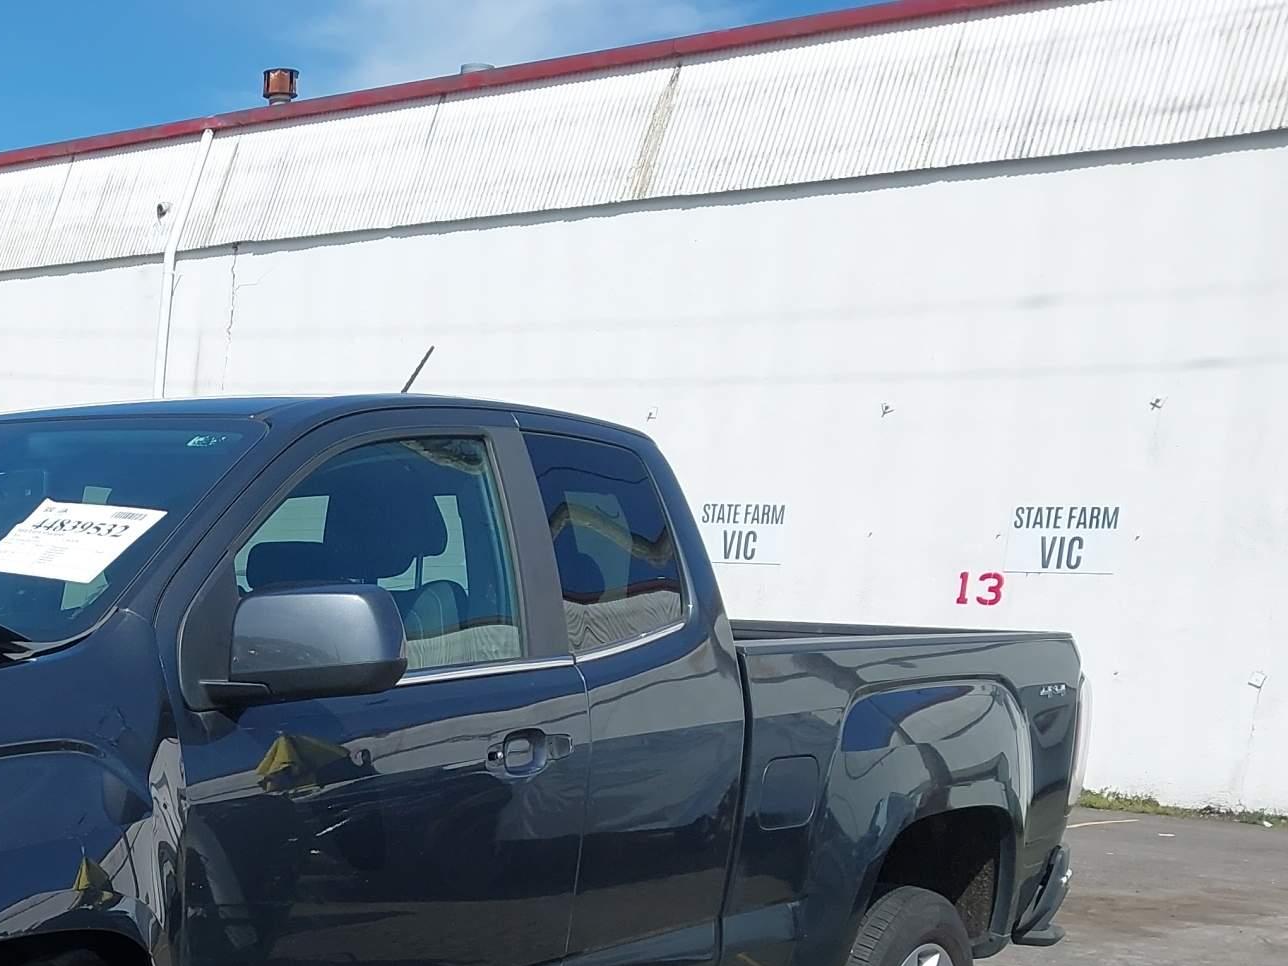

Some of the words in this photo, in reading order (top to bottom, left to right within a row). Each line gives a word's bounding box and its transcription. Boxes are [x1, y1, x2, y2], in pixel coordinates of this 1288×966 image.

[701, 503, 741, 524] STATE
[743, 504, 785, 525] FARM
[1013, 506, 1063, 529] STATE
[1067, 506, 1120, 530] FARM
[32, 518, 130, 538] 44839532
[723, 530, 757, 560] VIC
[1040, 536, 1084, 570] VIC
[956, 571, 1004, 606] 13
